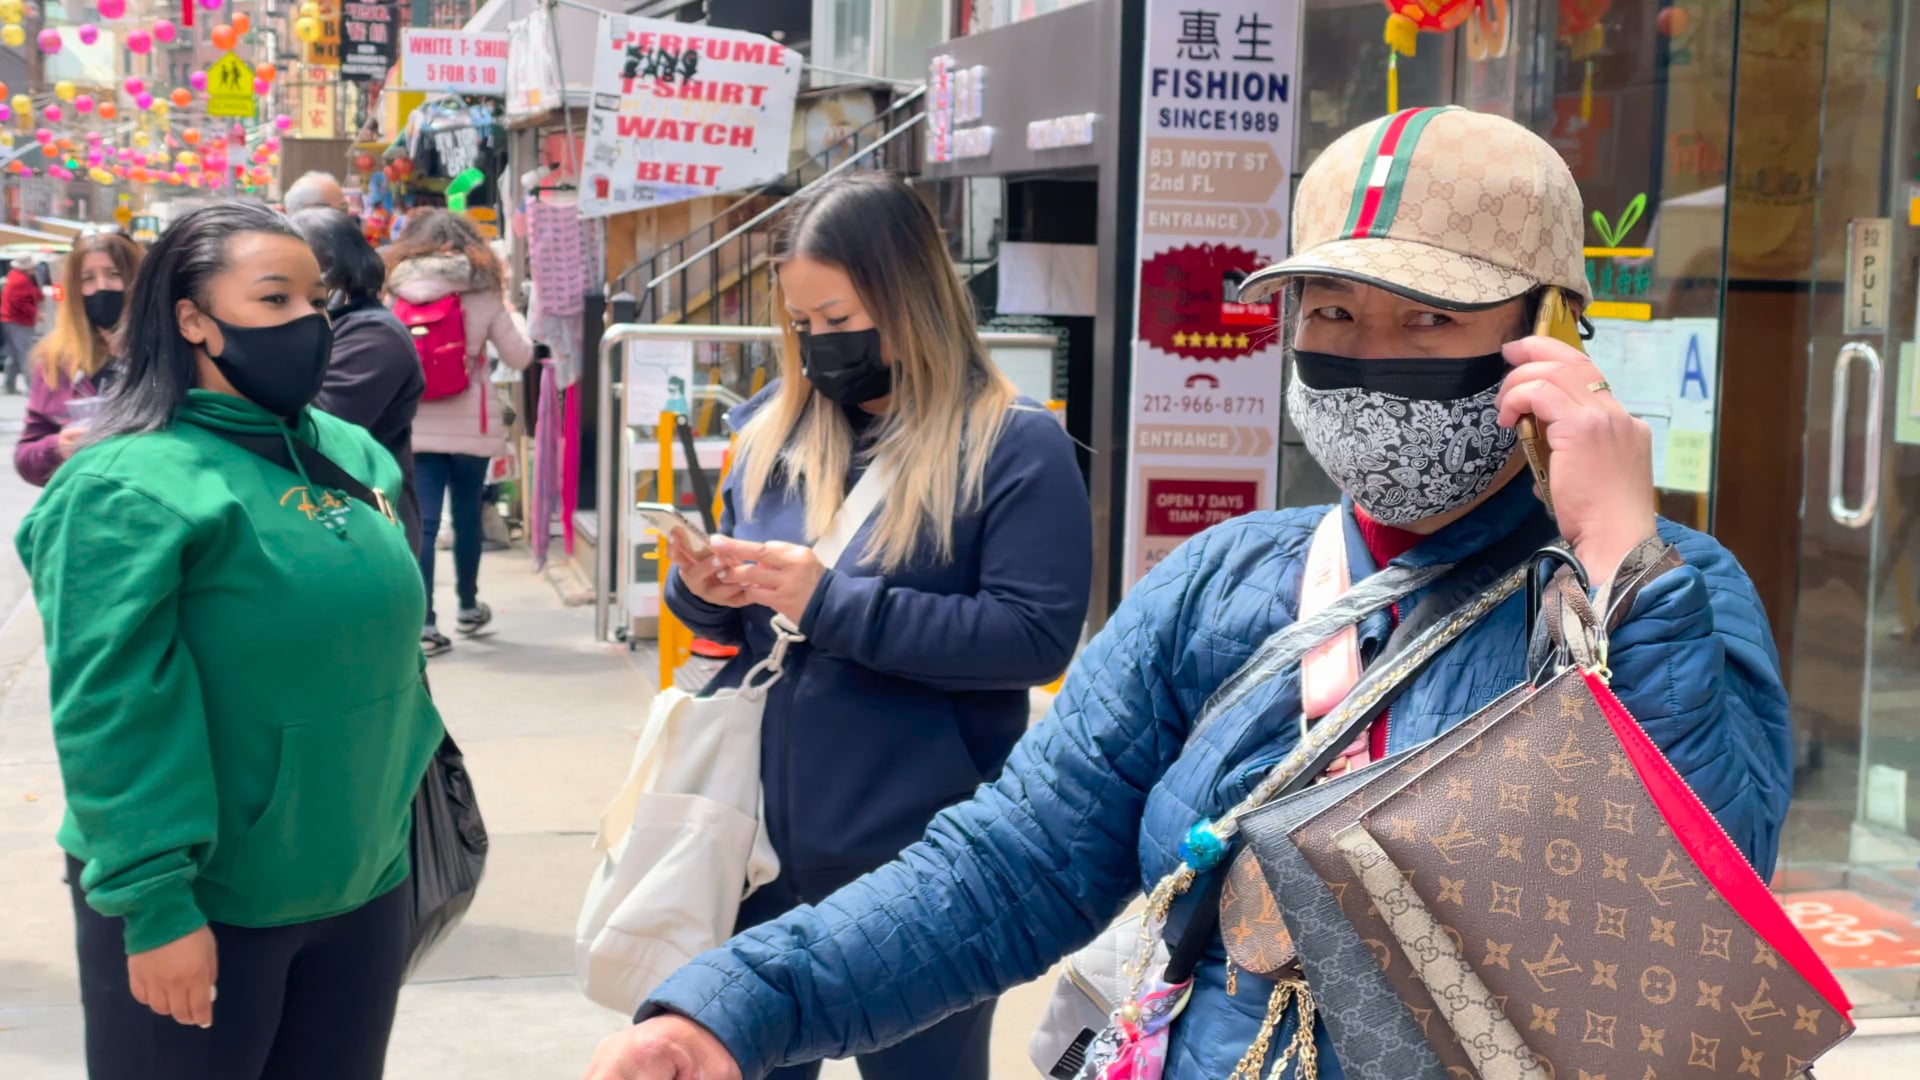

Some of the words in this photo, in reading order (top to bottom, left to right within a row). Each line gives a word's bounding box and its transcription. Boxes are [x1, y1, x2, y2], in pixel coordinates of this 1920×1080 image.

[409, 36, 453, 56] WHITE
[474, 39, 508, 58] SHIR
[1177, 10, 1275, 61] 惠生
[612, 31, 788, 67] PERFUME
[427, 63, 436, 82] 5
[440, 64, 465, 82] FOR
[483, 66, 496, 84] 10
[1152, 68, 1289, 102] FISHION
[620, 72, 768, 106] T-SHIRT
[617, 115, 755, 148] WATCH
[1159, 107, 1279, 133] SINCE1989
[636, 161, 722, 187] BELT
[1181, 151, 1237, 170] MOTT
[1243, 152, 1268, 171] ST
[1149, 173, 1184, 191] 2nd
[1192, 175, 1215, 193] FL
[1148, 210, 1239, 230] ENTRANCE
[1861, 255, 1876, 326] PULL
[1680, 333, 1709, 399] A
[1143, 394, 1264, 414] 212-966-8771
[1139, 431, 1230, 449] ENTRANCE
[1156, 493, 1195, 507] OPEN
[1197, 494, 1205, 507] 7
[1208, 494, 1244, 509] DAYS
